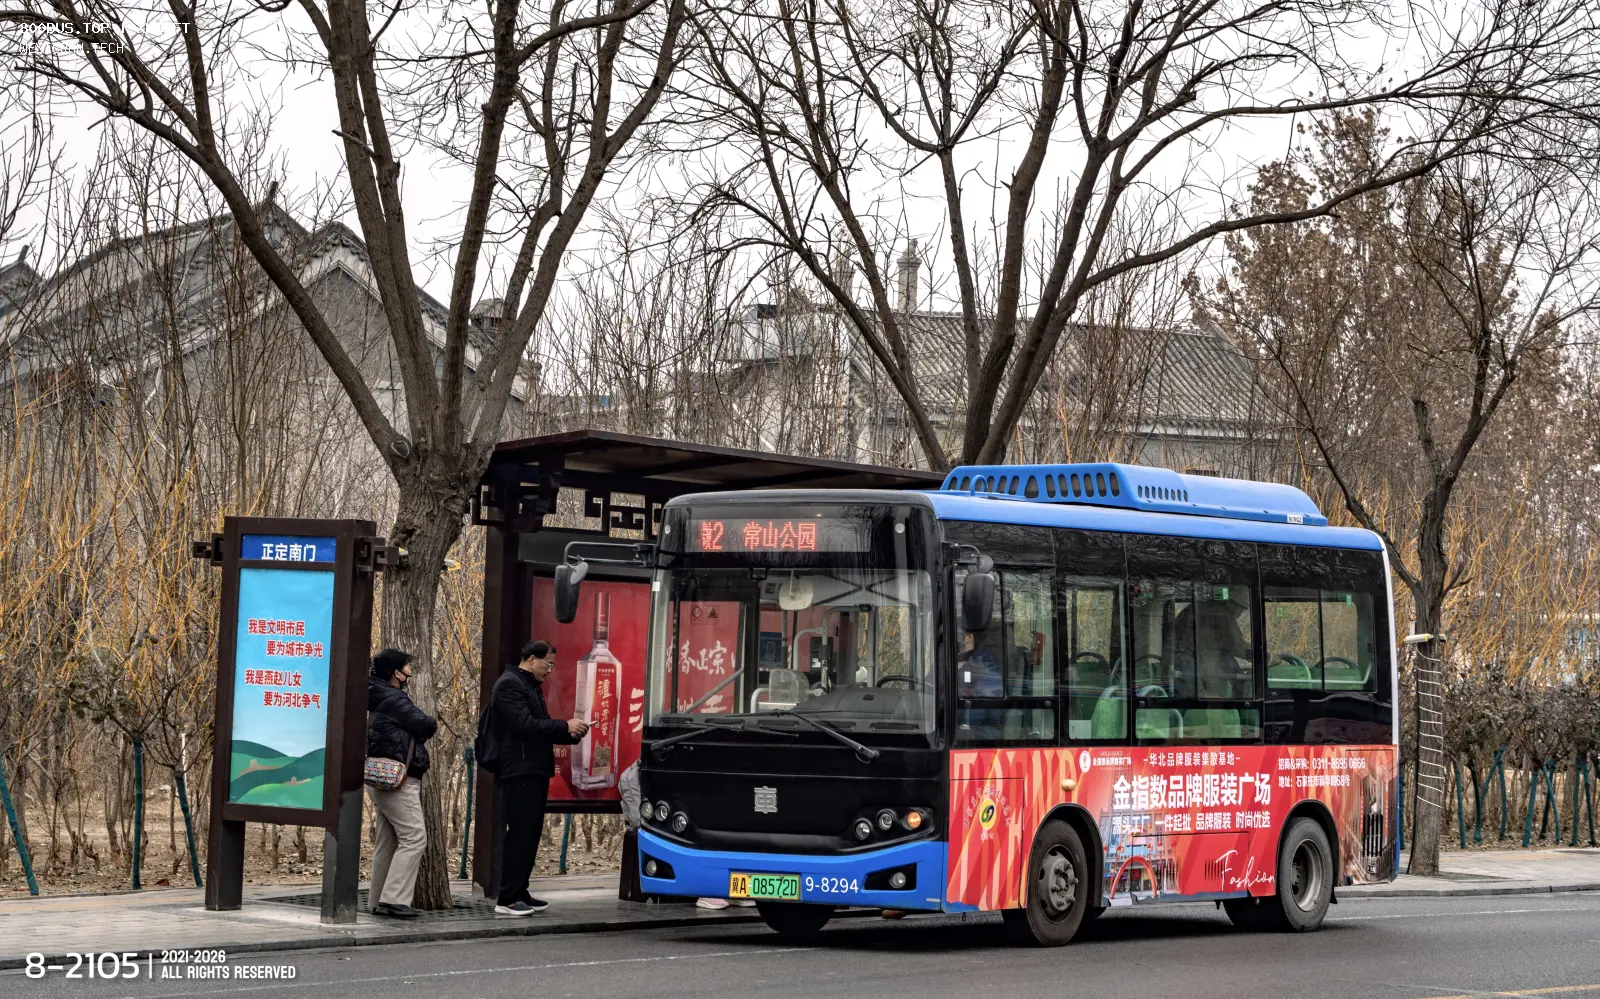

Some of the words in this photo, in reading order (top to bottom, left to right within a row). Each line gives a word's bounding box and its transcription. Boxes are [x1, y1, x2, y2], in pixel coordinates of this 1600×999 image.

[743, 521, 816, 550] 常山公园
[261, 543, 317, 561] 正定南门
[248, 619, 305, 636] 我是文明市民
[266, 640, 323, 658] 要为城市争光
[245, 669, 302, 687] 我是燕赵儿女
[263, 691, 321, 709] 要为河北争气
[1112, 773, 1272, 811] 金指数品牌服装广场
[1112, 816, 1151, 836] 源头工厂
[1155, 813, 1192, 832] 一件起批
[1195, 812, 1231, 830] 品牌服装
[1235, 811, 1271, 829] 时尚优选
[1216, 849, 1276, 892] Fashion
[805, 876, 859, 894] 9-8294
